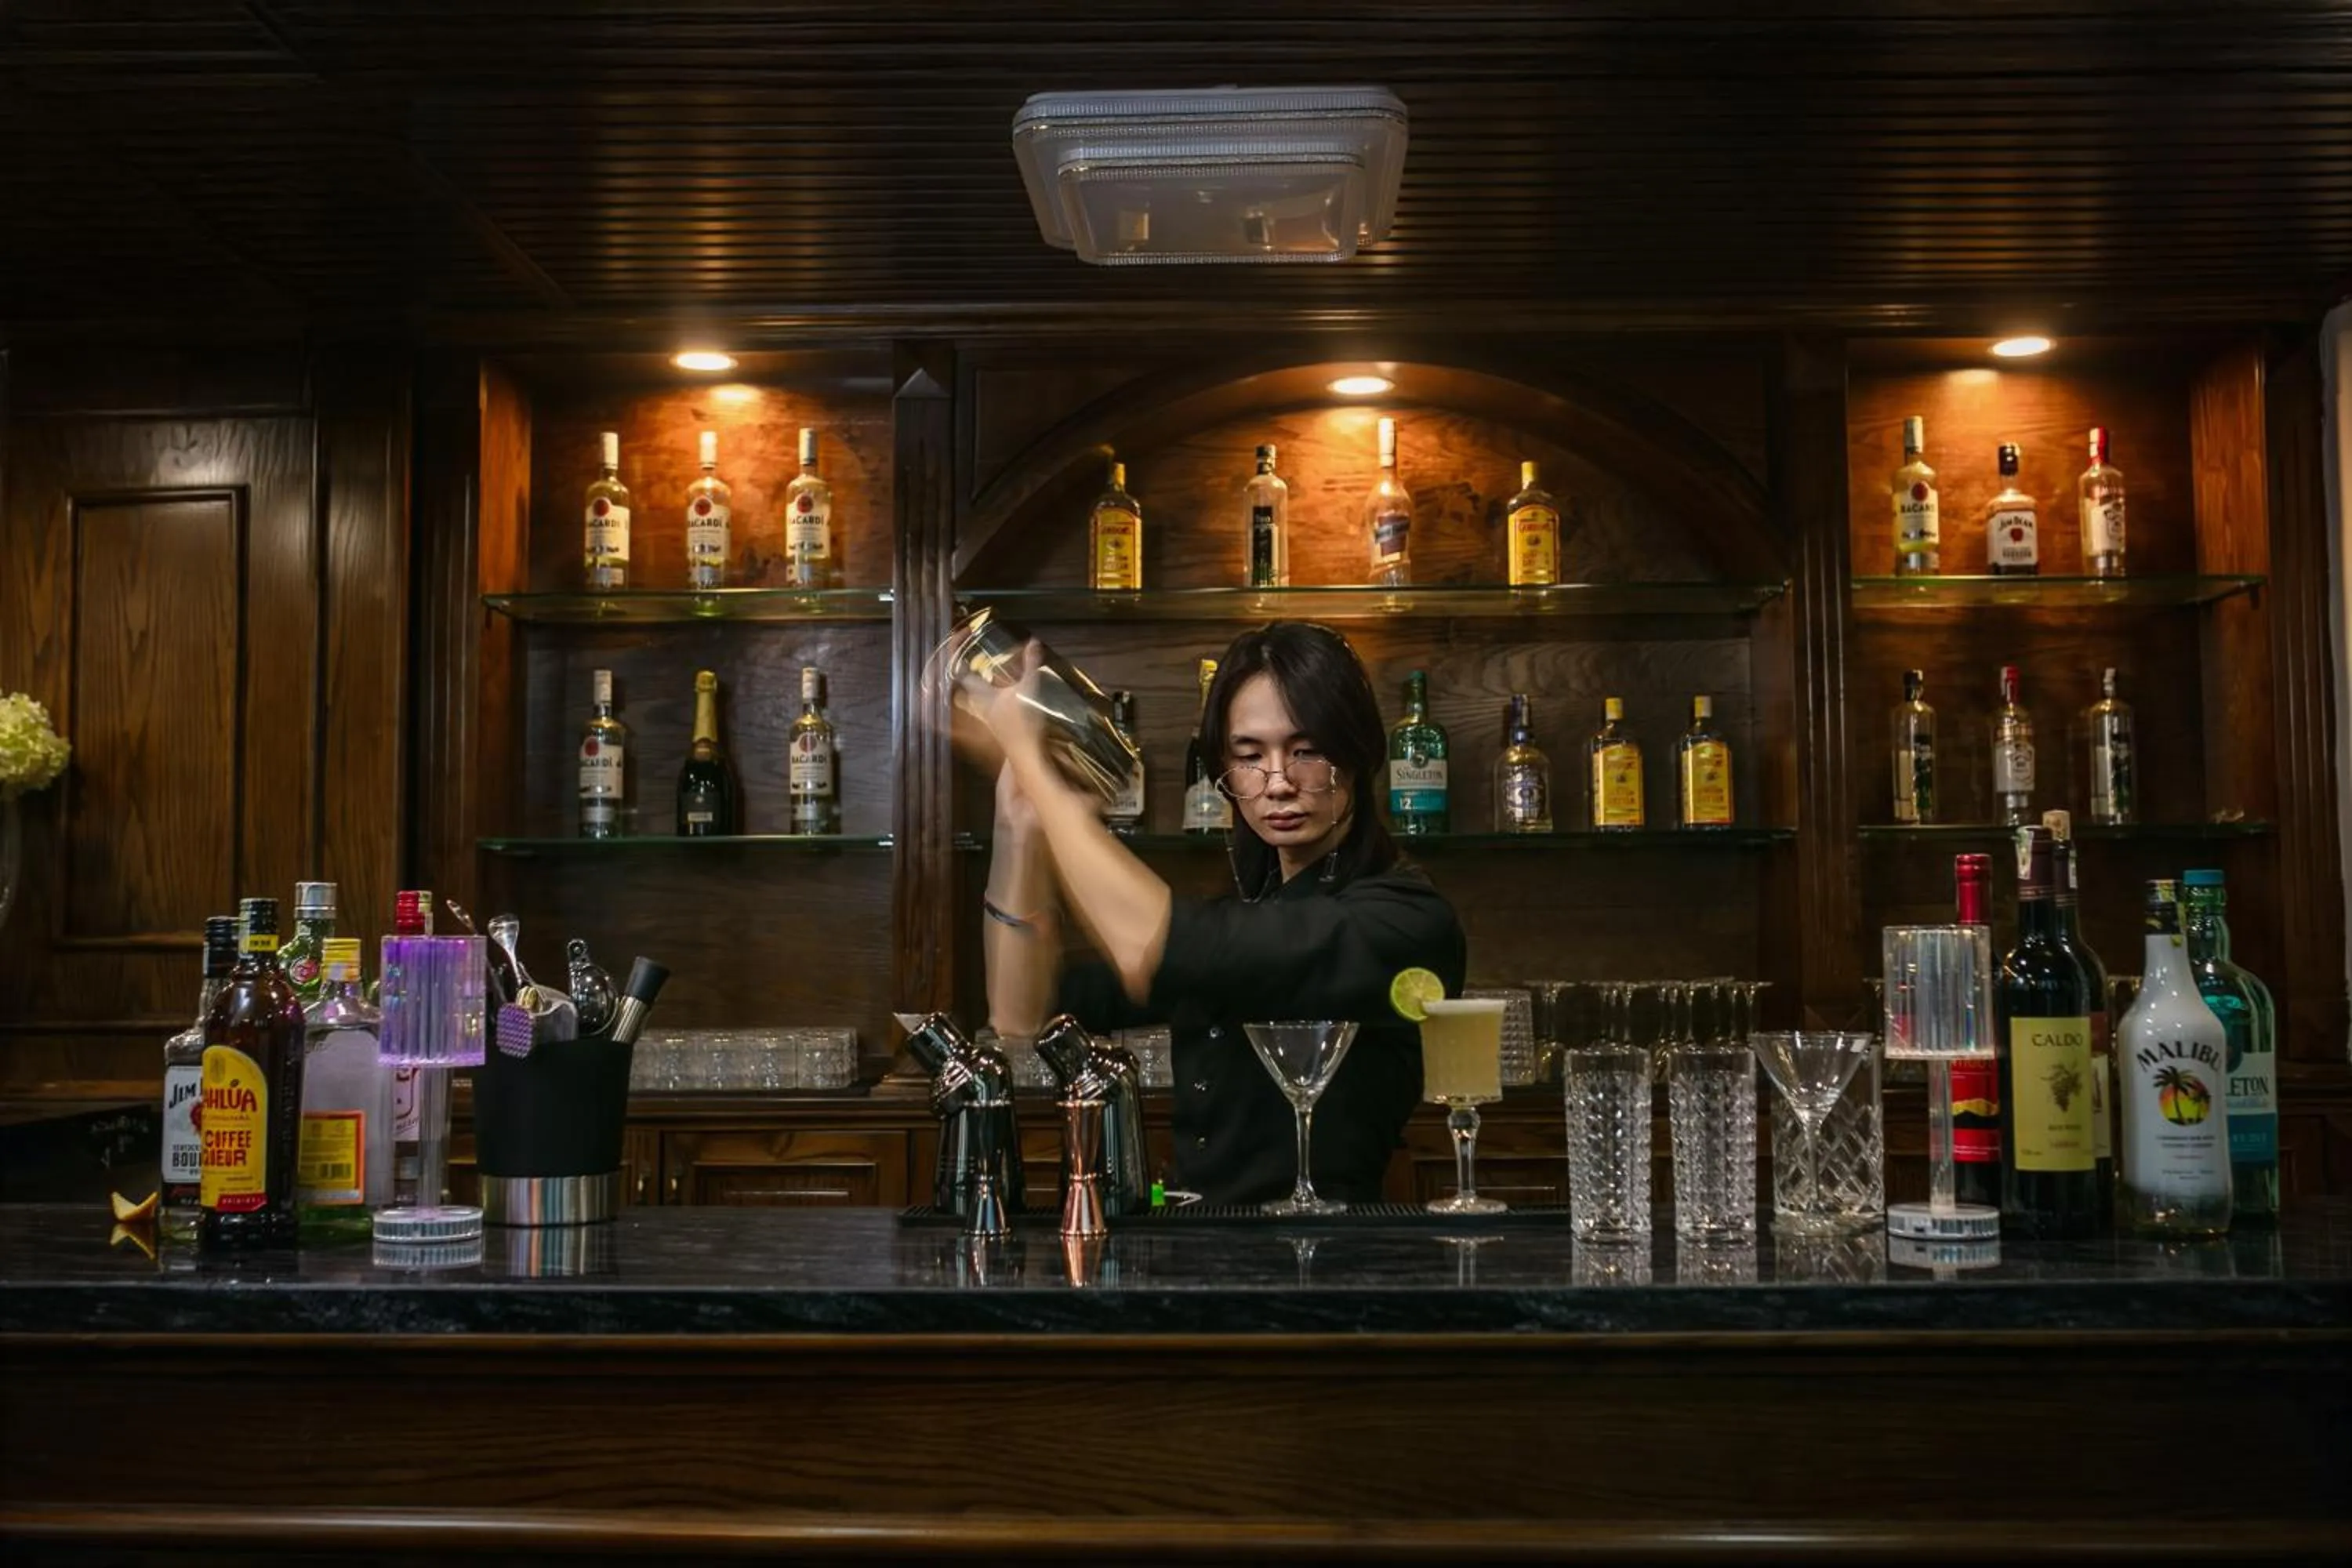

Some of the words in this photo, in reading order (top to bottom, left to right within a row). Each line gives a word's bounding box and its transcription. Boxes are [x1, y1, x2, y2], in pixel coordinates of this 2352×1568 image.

[2031, 1033, 2083, 1047] CALDO
[2136, 1040, 2223, 1073] MALIBU
[169, 1083, 196, 1109] JIM
[203, 1079, 257, 1112] AHLÚA
[205, 1130, 252, 1149] COFFEE
[203, 1149, 247, 1167] QUEUR
